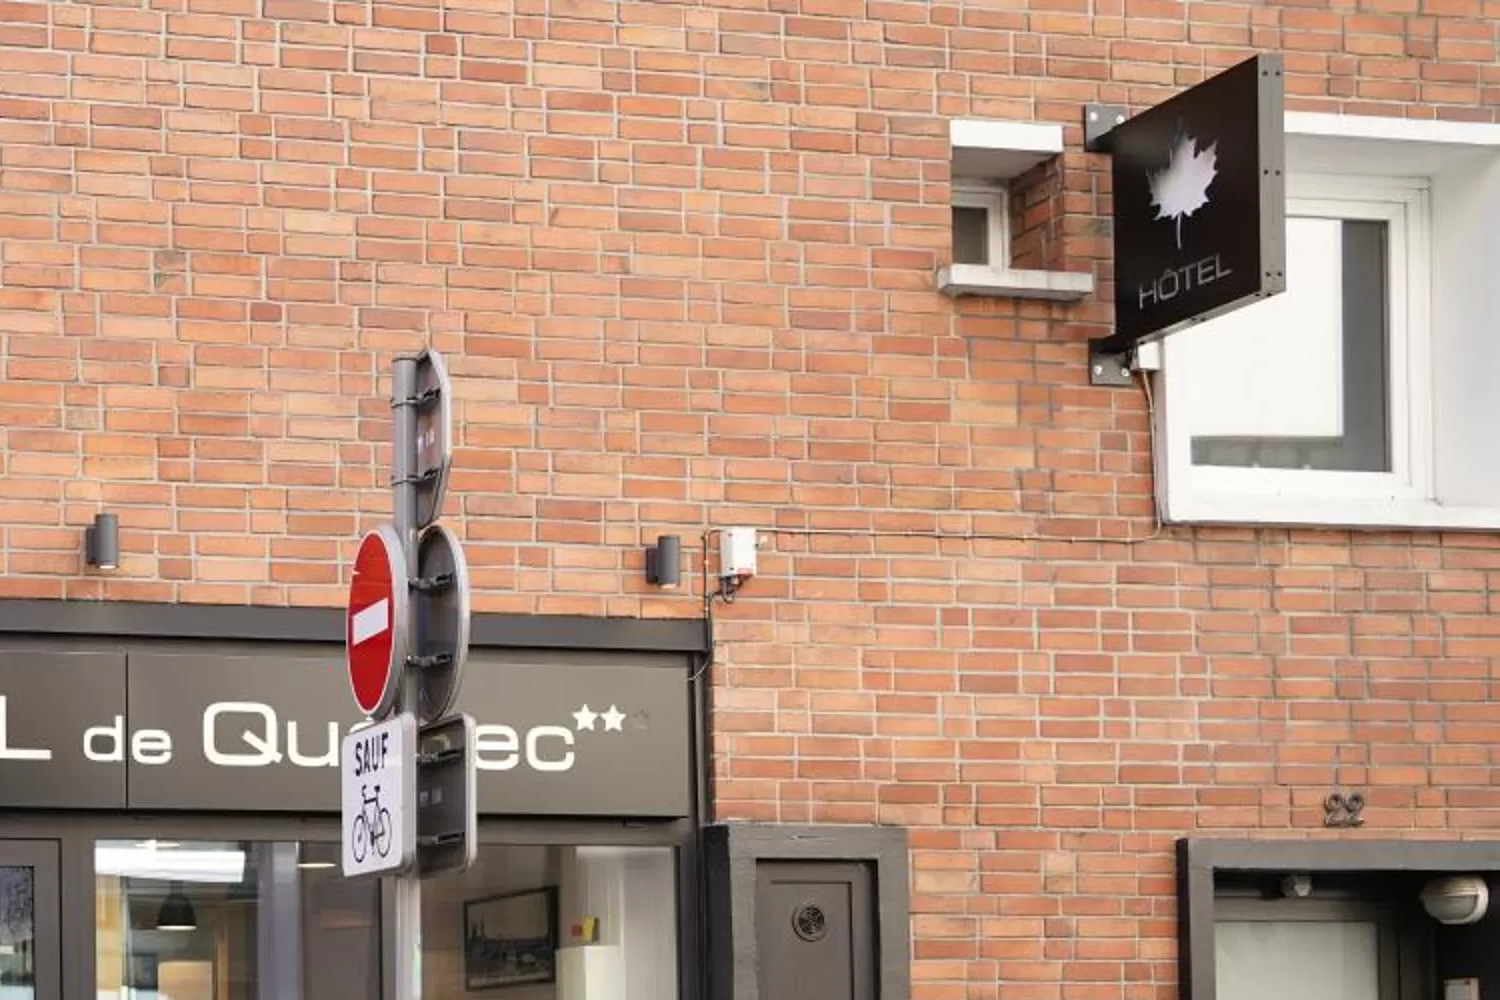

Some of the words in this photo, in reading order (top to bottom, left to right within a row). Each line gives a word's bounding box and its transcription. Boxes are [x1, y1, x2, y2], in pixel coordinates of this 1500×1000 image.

[1139, 253, 1234, 309] HÔTEL
[83, 716, 172, 764] de
[203, 702, 576, 772] Quec
[355, 732, 389, 777] SAUF
[1323, 792, 1365, 828] 22
